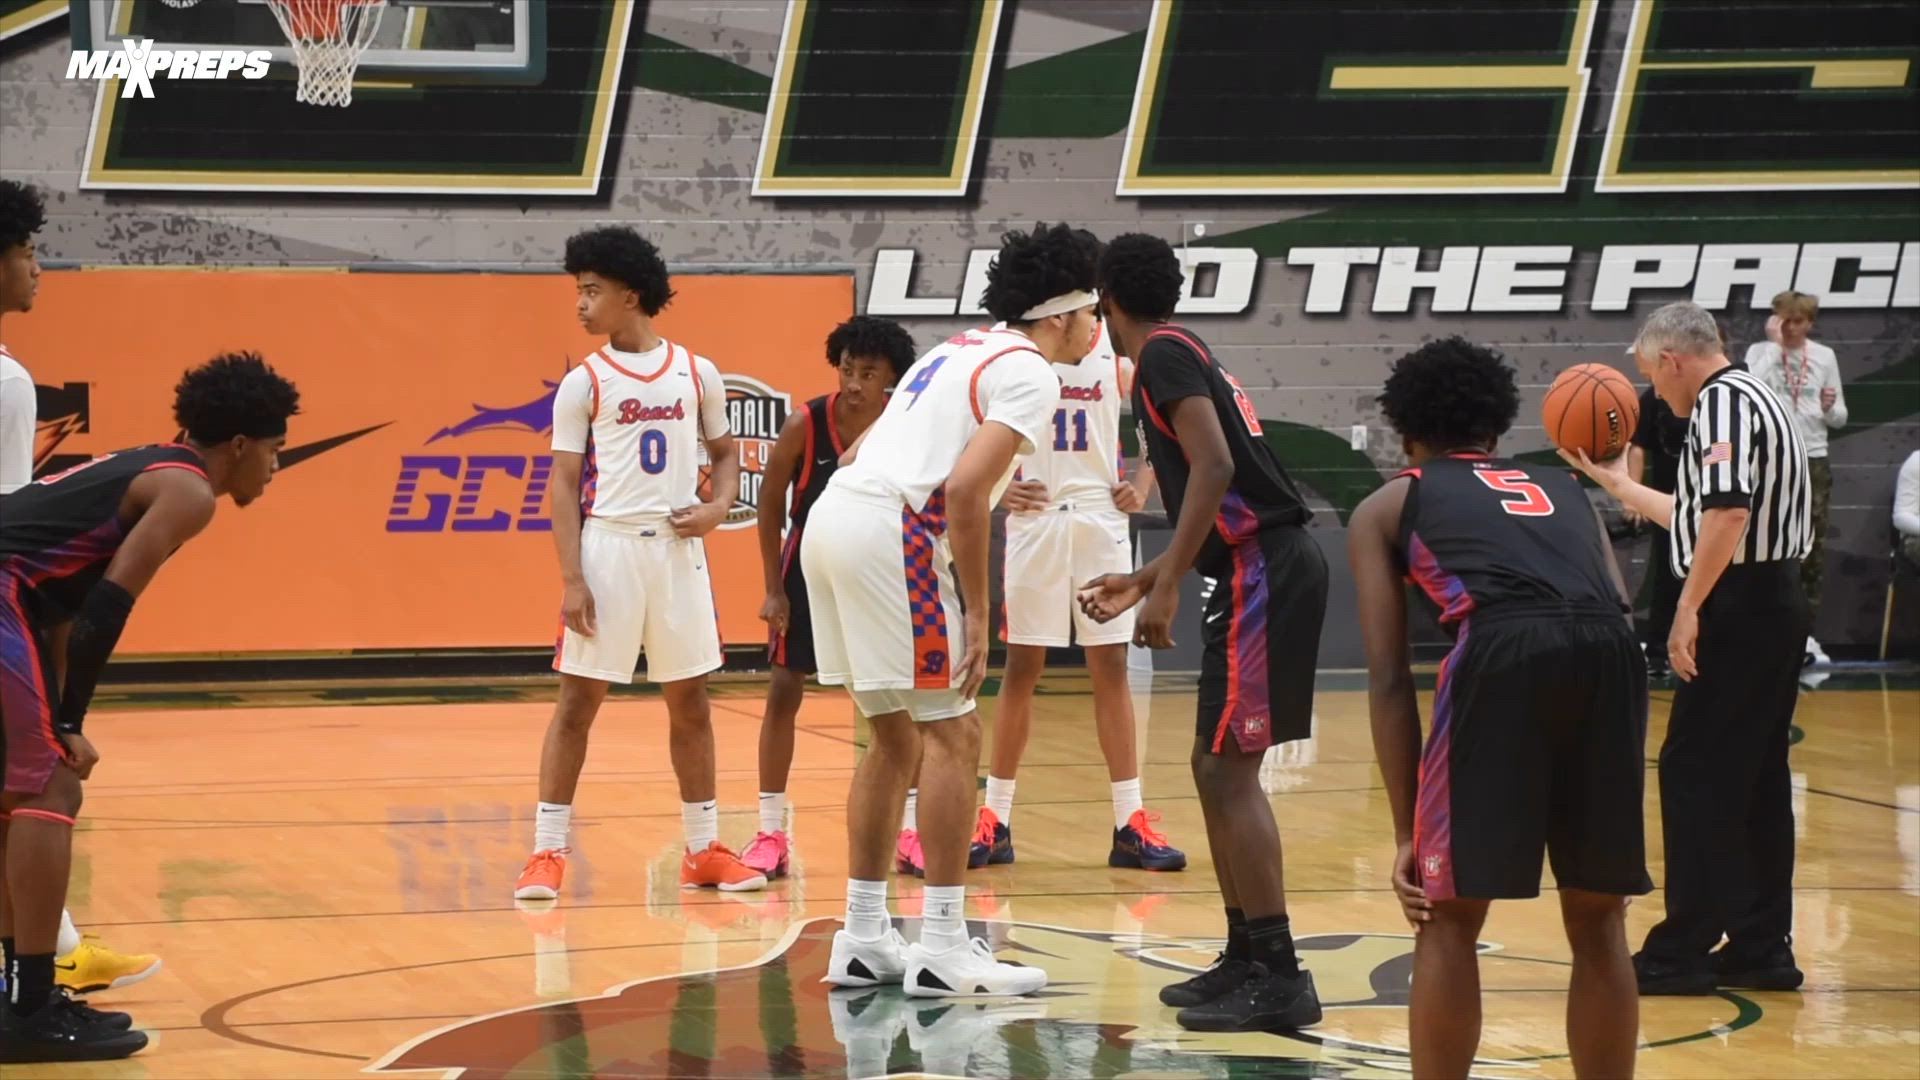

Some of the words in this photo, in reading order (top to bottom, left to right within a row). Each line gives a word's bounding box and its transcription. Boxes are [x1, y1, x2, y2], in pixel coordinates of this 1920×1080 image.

[867, 248, 1259, 316] LD
[1287, 245, 1574, 313] THE
[1590, 241, 1920, 311] PAC
[903, 355, 949, 412] 4
[1056, 375, 1103, 401] each
[615, 397, 685, 425] Beach
[726, 399, 780, 438] BALL
[1052, 408, 1089, 452] 11
[639, 428, 668, 475] 0
[1472, 469, 1555, 516] 5
